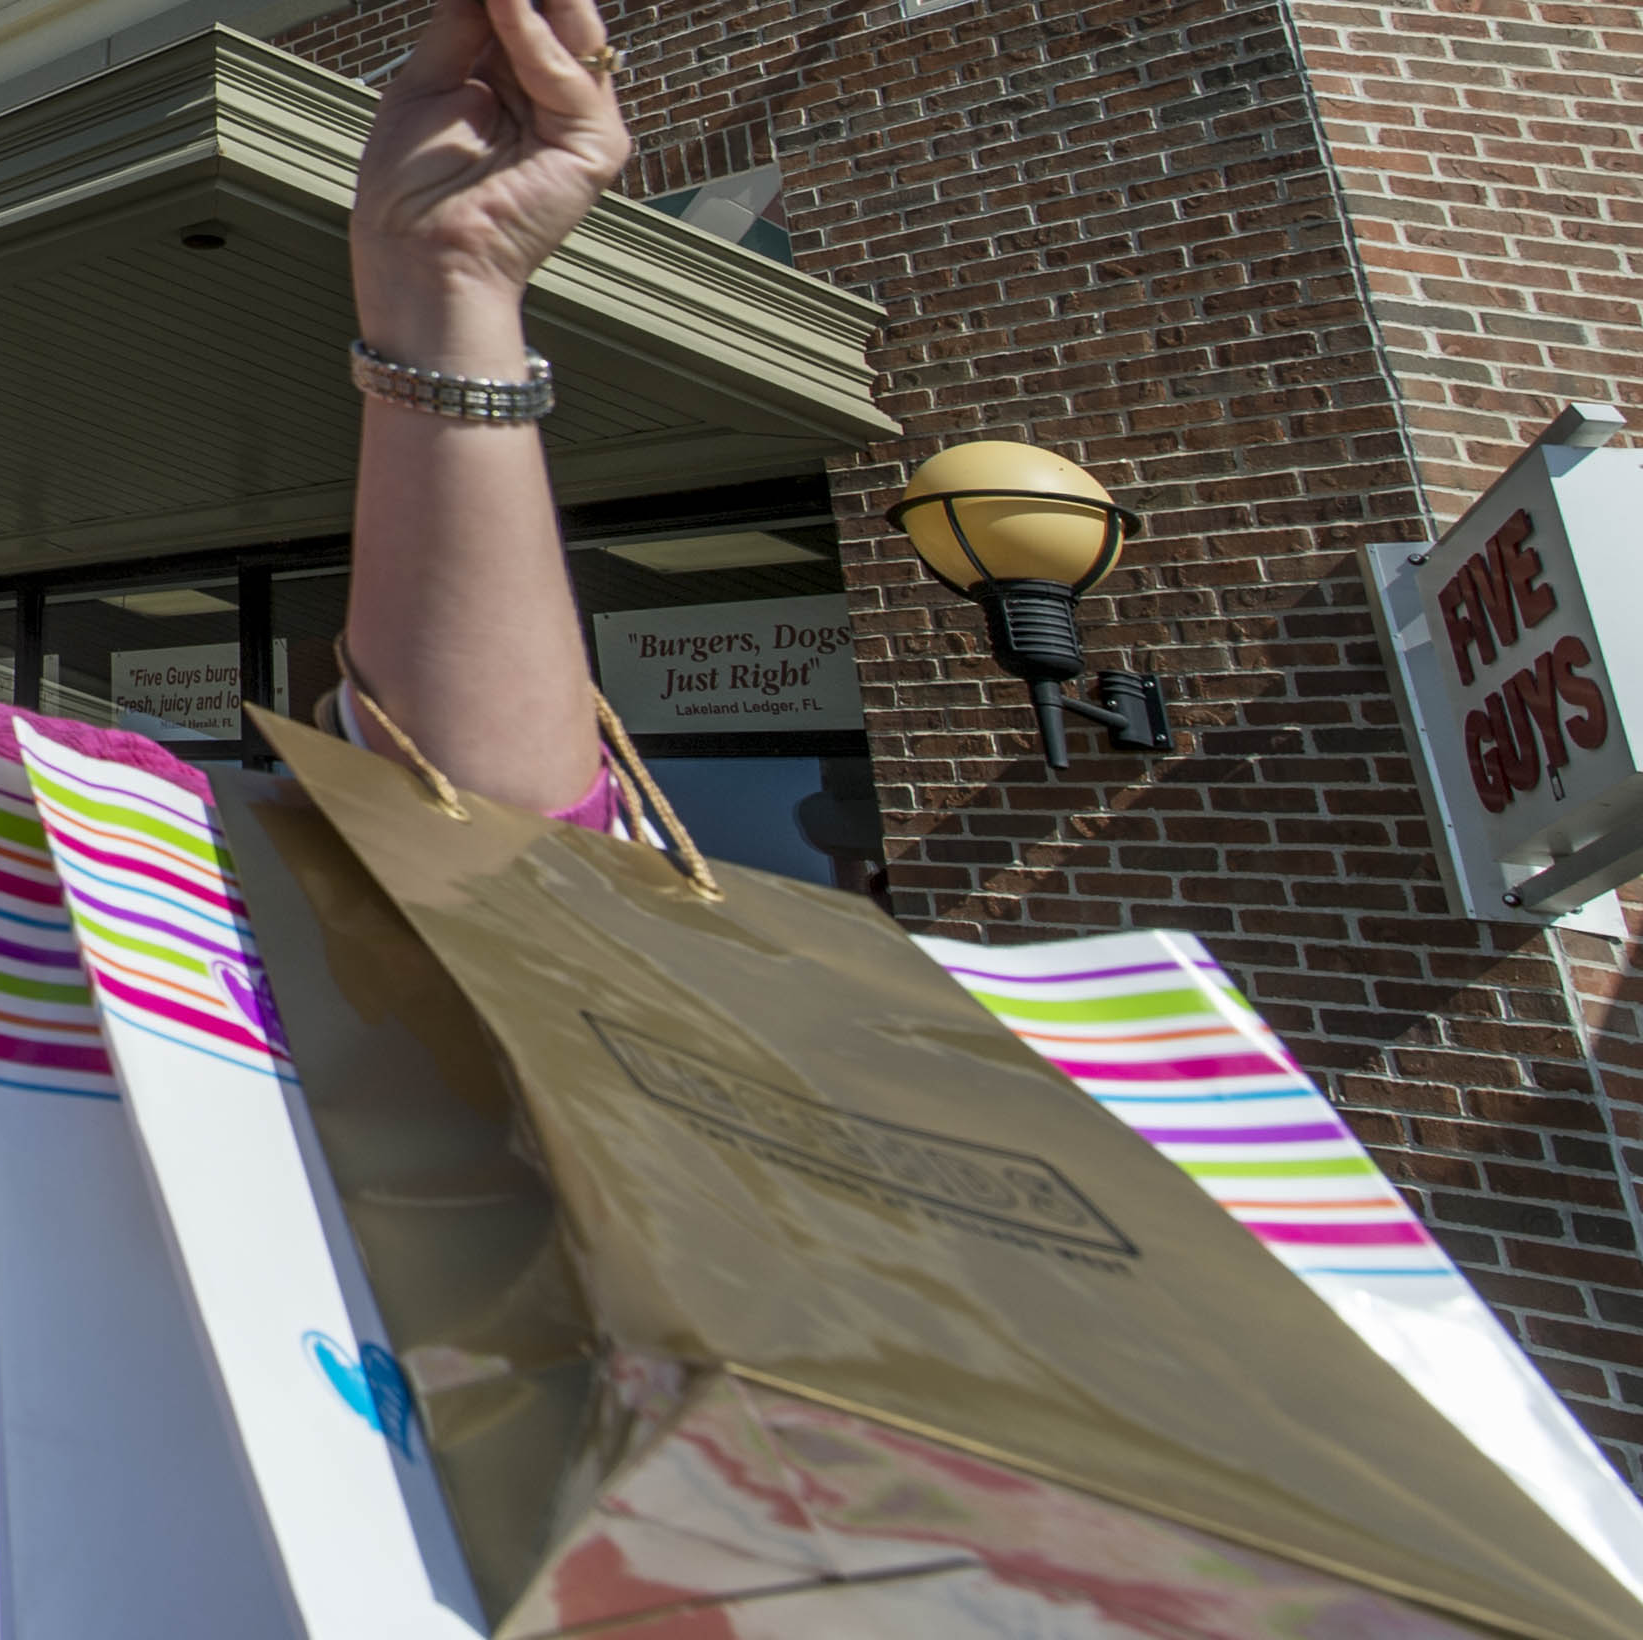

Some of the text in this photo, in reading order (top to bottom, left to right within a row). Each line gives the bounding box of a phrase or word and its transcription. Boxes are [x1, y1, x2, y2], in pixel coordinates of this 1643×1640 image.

[1437, 507, 1557, 688] FIVE
[628, 623, 852, 662] "Burgers, Dogs
[129, 664, 241, 689] "Five Guys burg
[660, 657, 820, 700] Just Right"
[159, 693, 192, 717] juicy
[196, 690, 224, 711] and
[675, 698, 823, 717] Lakeland Ledger, FL
[1464, 634, 1608, 814] GUYS
